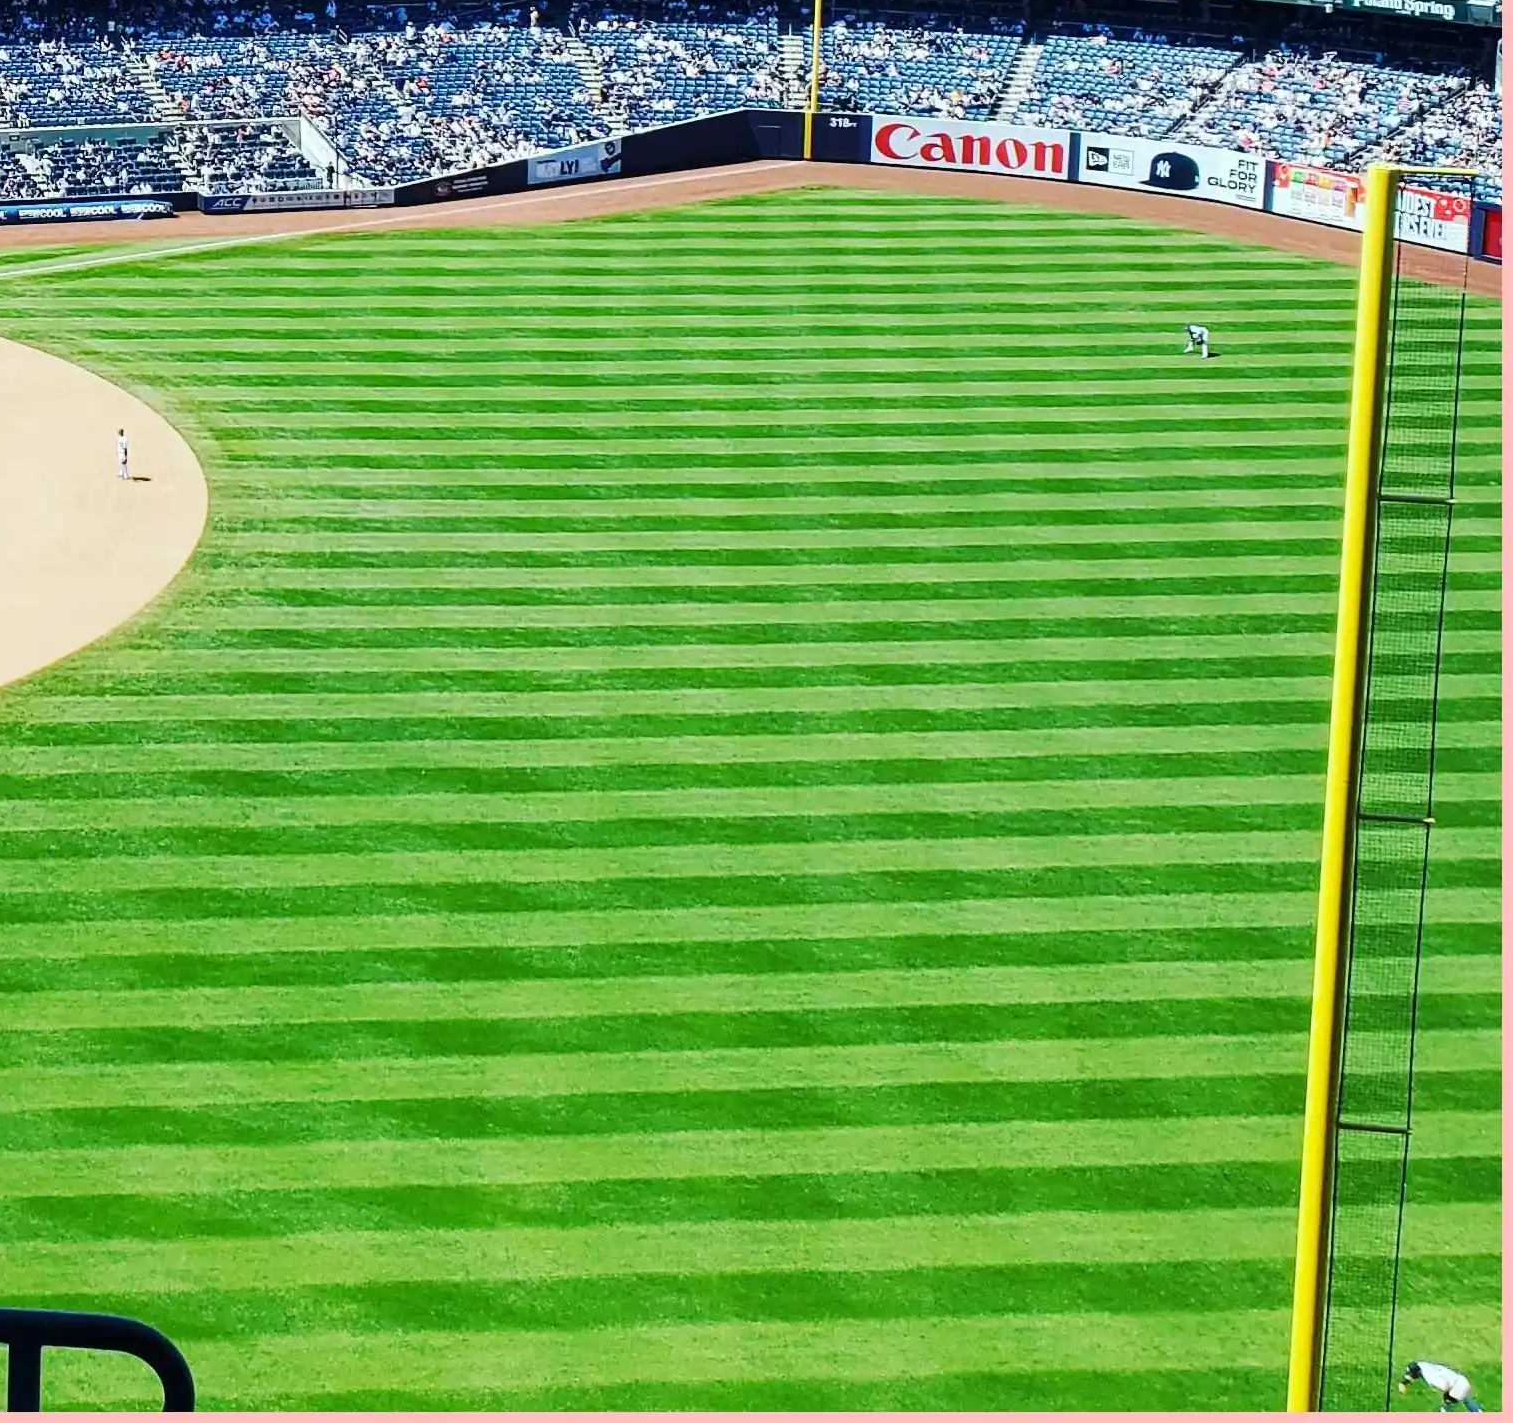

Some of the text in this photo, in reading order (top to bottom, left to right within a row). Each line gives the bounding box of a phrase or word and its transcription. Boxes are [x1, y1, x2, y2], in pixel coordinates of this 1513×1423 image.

[875, 123, 1064, 174] Canon
[1238, 159, 1258, 172] FIT
[1229, 169, 1258, 182] FOR
[1207, 176, 1257, 194] GLORY
[212, 197, 242, 207] ACC
